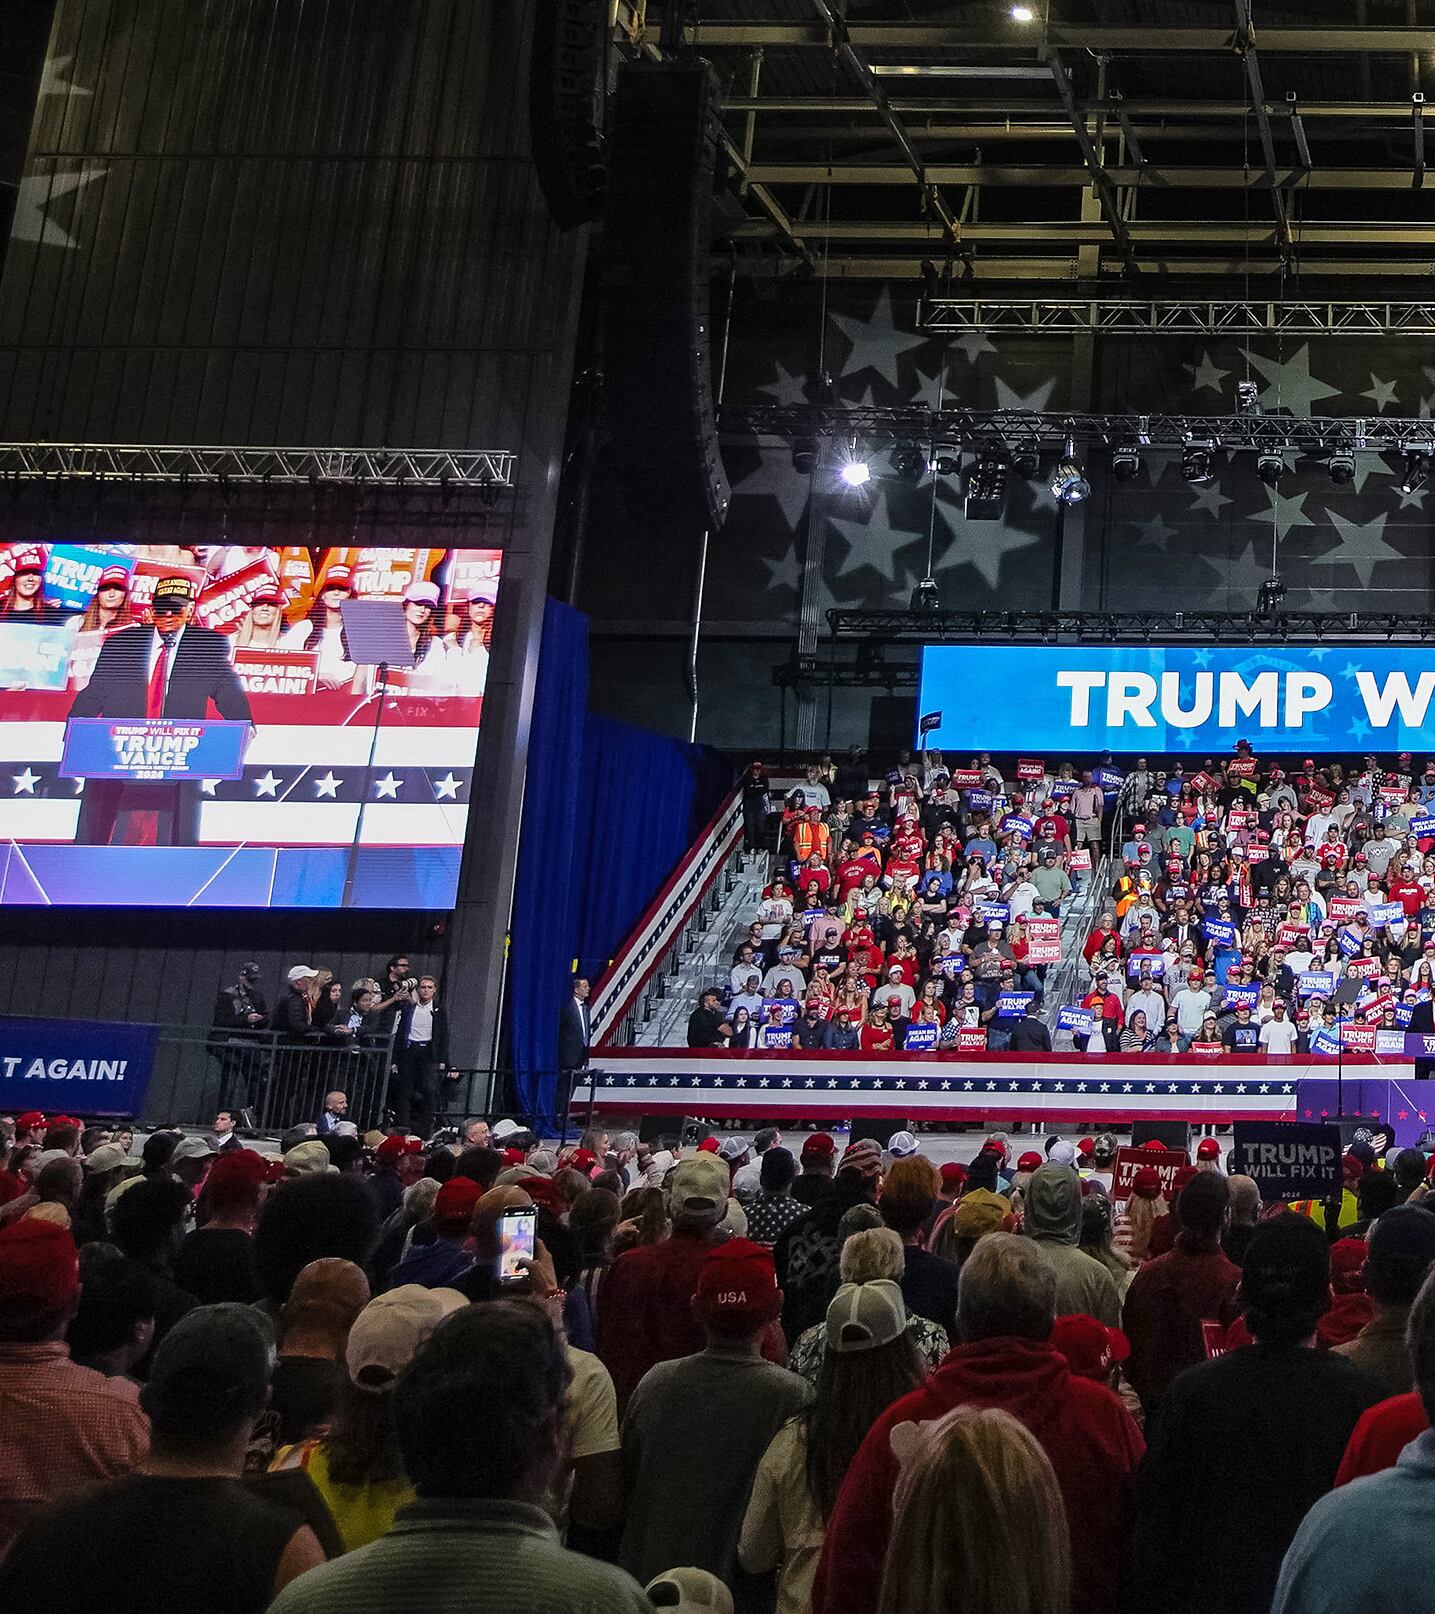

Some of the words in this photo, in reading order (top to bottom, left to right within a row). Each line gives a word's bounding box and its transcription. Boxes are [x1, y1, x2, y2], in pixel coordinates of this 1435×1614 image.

[236, 665, 283, 678] DREAM
[1056, 672, 1334, 727] TRUMP
[149, 727, 172, 735] WILL
[113, 736, 199, 752] TRUMP
[120, 751, 187, 765] VANCE
[1031, 945, 1060, 953] TRUMP
[1226, 990, 1257, 998] TRUMP
[1002, 998, 1032, 1006] TRUMP
[1060, 1016, 1089, 1027] AGAIN!
[909, 1034, 935, 1042] AGAIN!
[25, 1058, 128, 1081] AGAIN!
[1242, 1143, 1335, 1166] TRUMP
[1244, 1164, 1286, 1179] WILL
[1291, 1164, 1317, 1179] FIX
[1321, 1167, 1335, 1179] IT
[718, 1291, 747, 1304] USA
